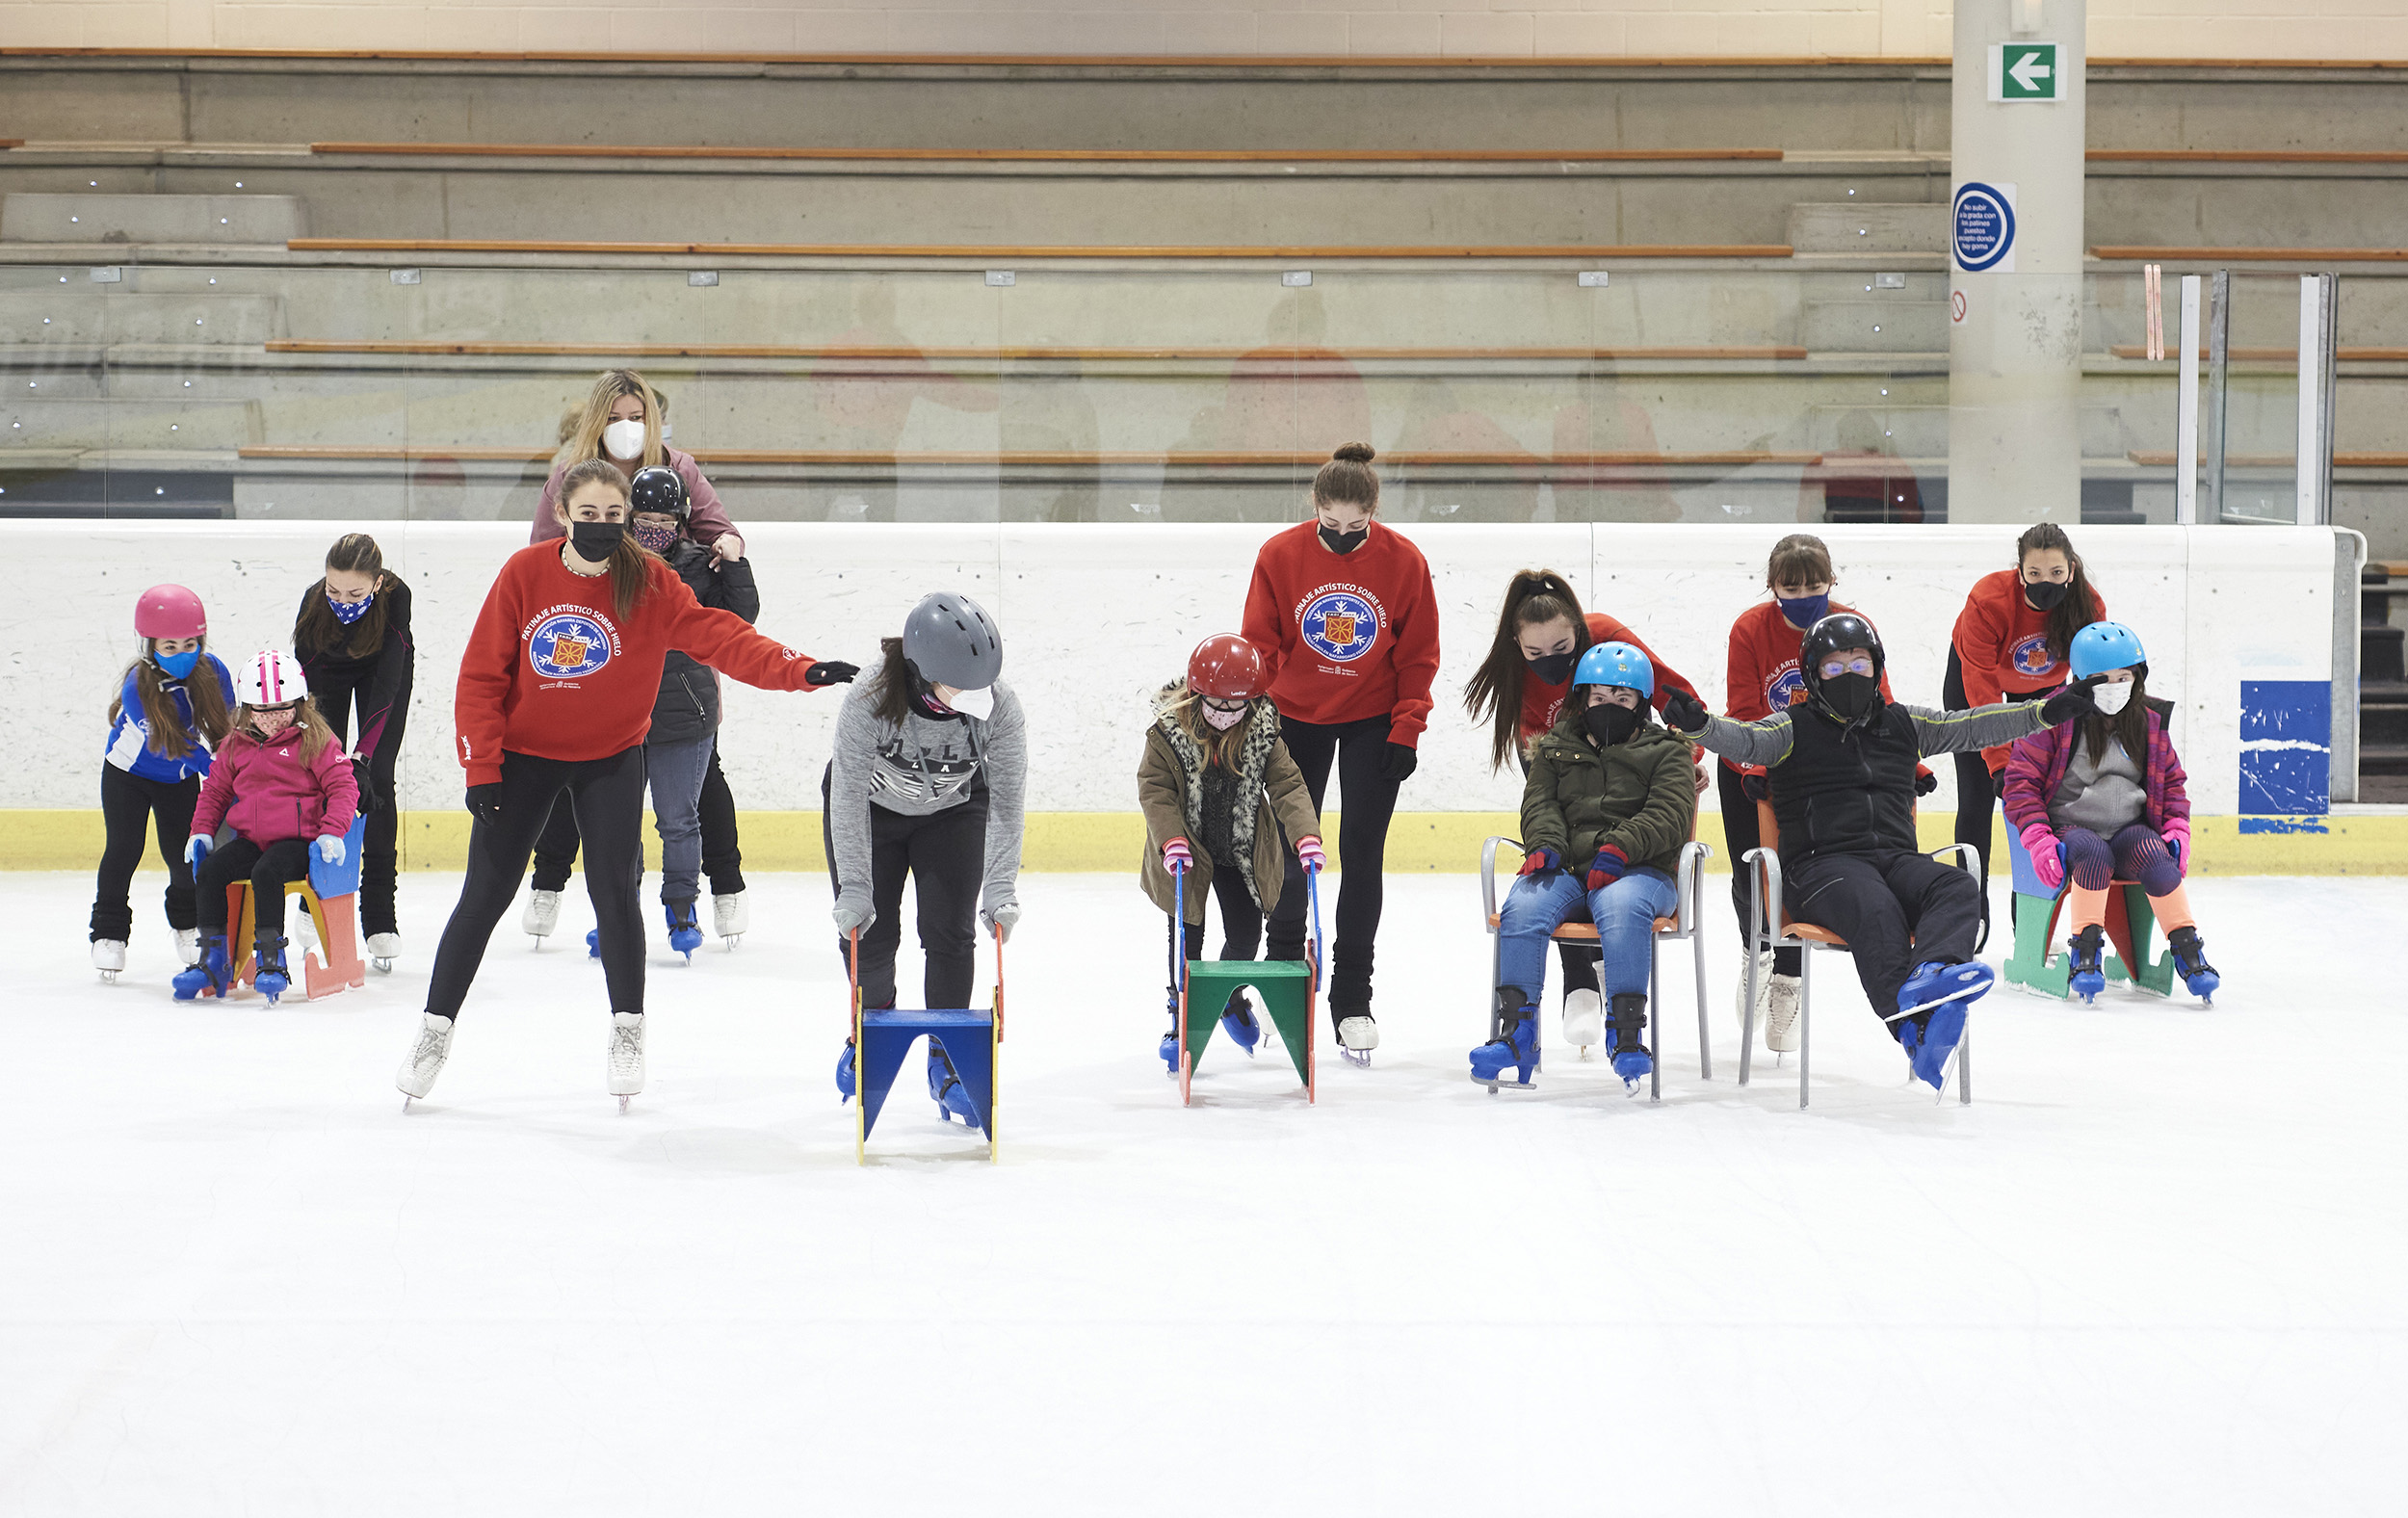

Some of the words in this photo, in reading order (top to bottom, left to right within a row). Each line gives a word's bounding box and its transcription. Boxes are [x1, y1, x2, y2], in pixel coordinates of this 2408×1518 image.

[521, 608, 550, 641] PATINAJE
[550, 603, 593, 615] ARTÍSTICO
[592, 610, 616, 633] SOBRE
[611, 633, 622, 656] HIELO
[1295, 590, 1315, 624] ATINAJE
[1314, 582, 1357, 597] ARTÍSTICO
[1356, 586, 1380, 607] SOBRE
[1376, 604, 1387, 628] HIELO
